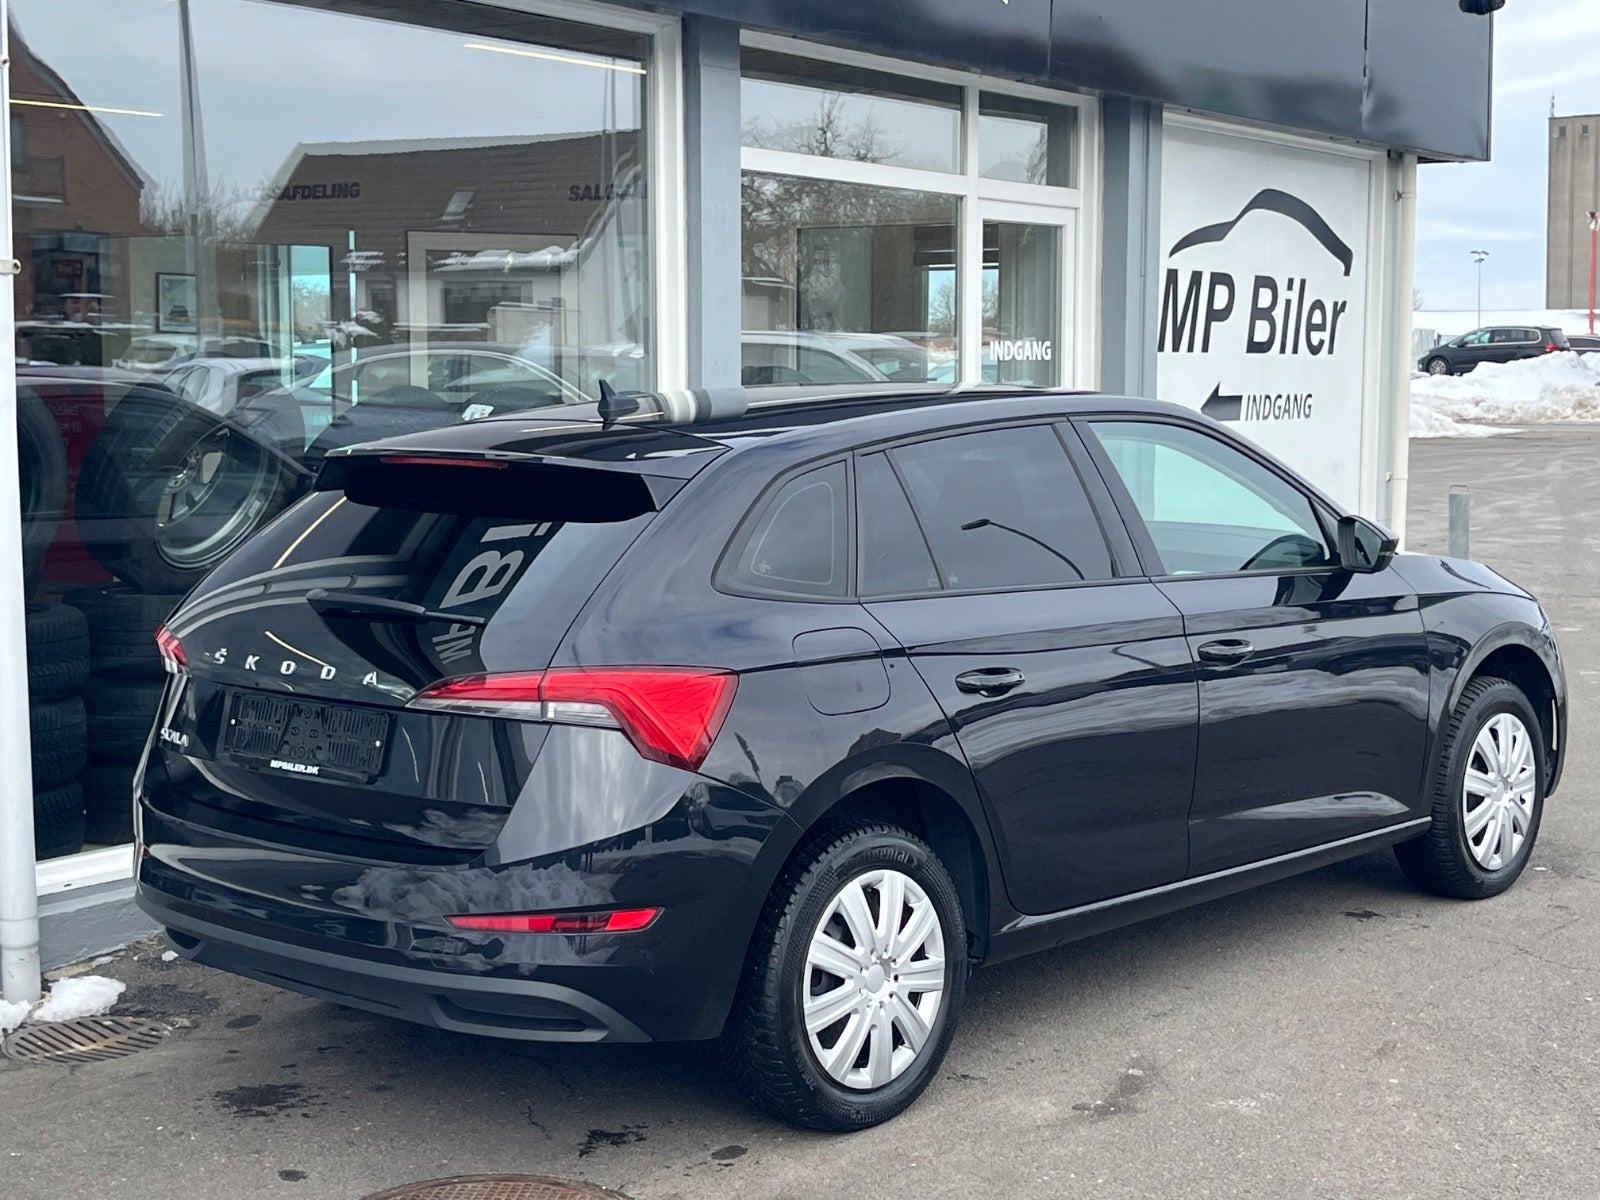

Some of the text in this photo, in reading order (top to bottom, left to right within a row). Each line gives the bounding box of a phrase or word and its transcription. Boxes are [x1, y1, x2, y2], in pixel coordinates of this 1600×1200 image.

[1157, 268, 1347, 356] MP Biler
[989, 340, 1052, 361] INDGANG
[1245, 393, 1313, 421] INDGANG
[213, 648, 378, 687] ŠKODA
[270, 760, 320, 775] MPBILER.DK
